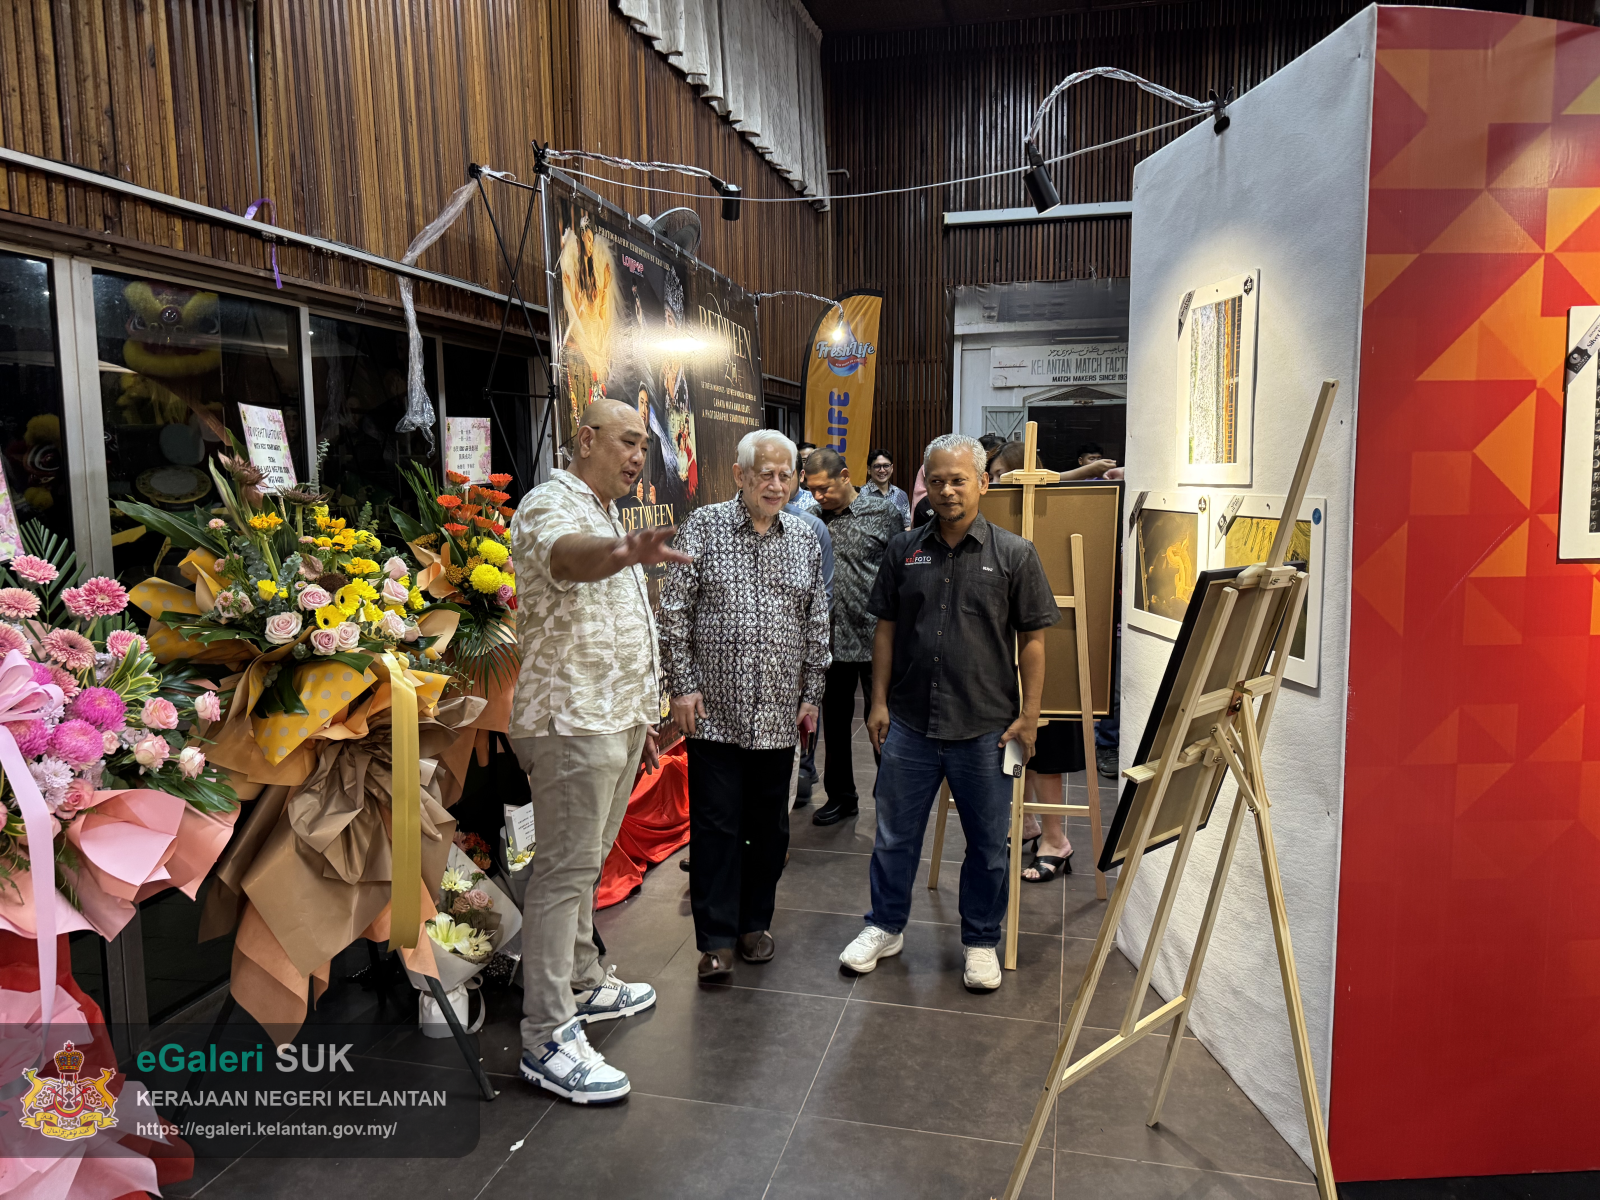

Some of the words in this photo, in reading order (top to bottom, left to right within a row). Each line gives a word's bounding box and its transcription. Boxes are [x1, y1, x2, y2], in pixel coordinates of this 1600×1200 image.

[698, 304, 752, 364] BETWEEN
[816, 341, 875, 359] FreshLife
[1031, 358, 1072, 375] KELANTAN
[1075, 357, 1101, 374] MATCH
[622, 502, 675, 532] BETWEEN
